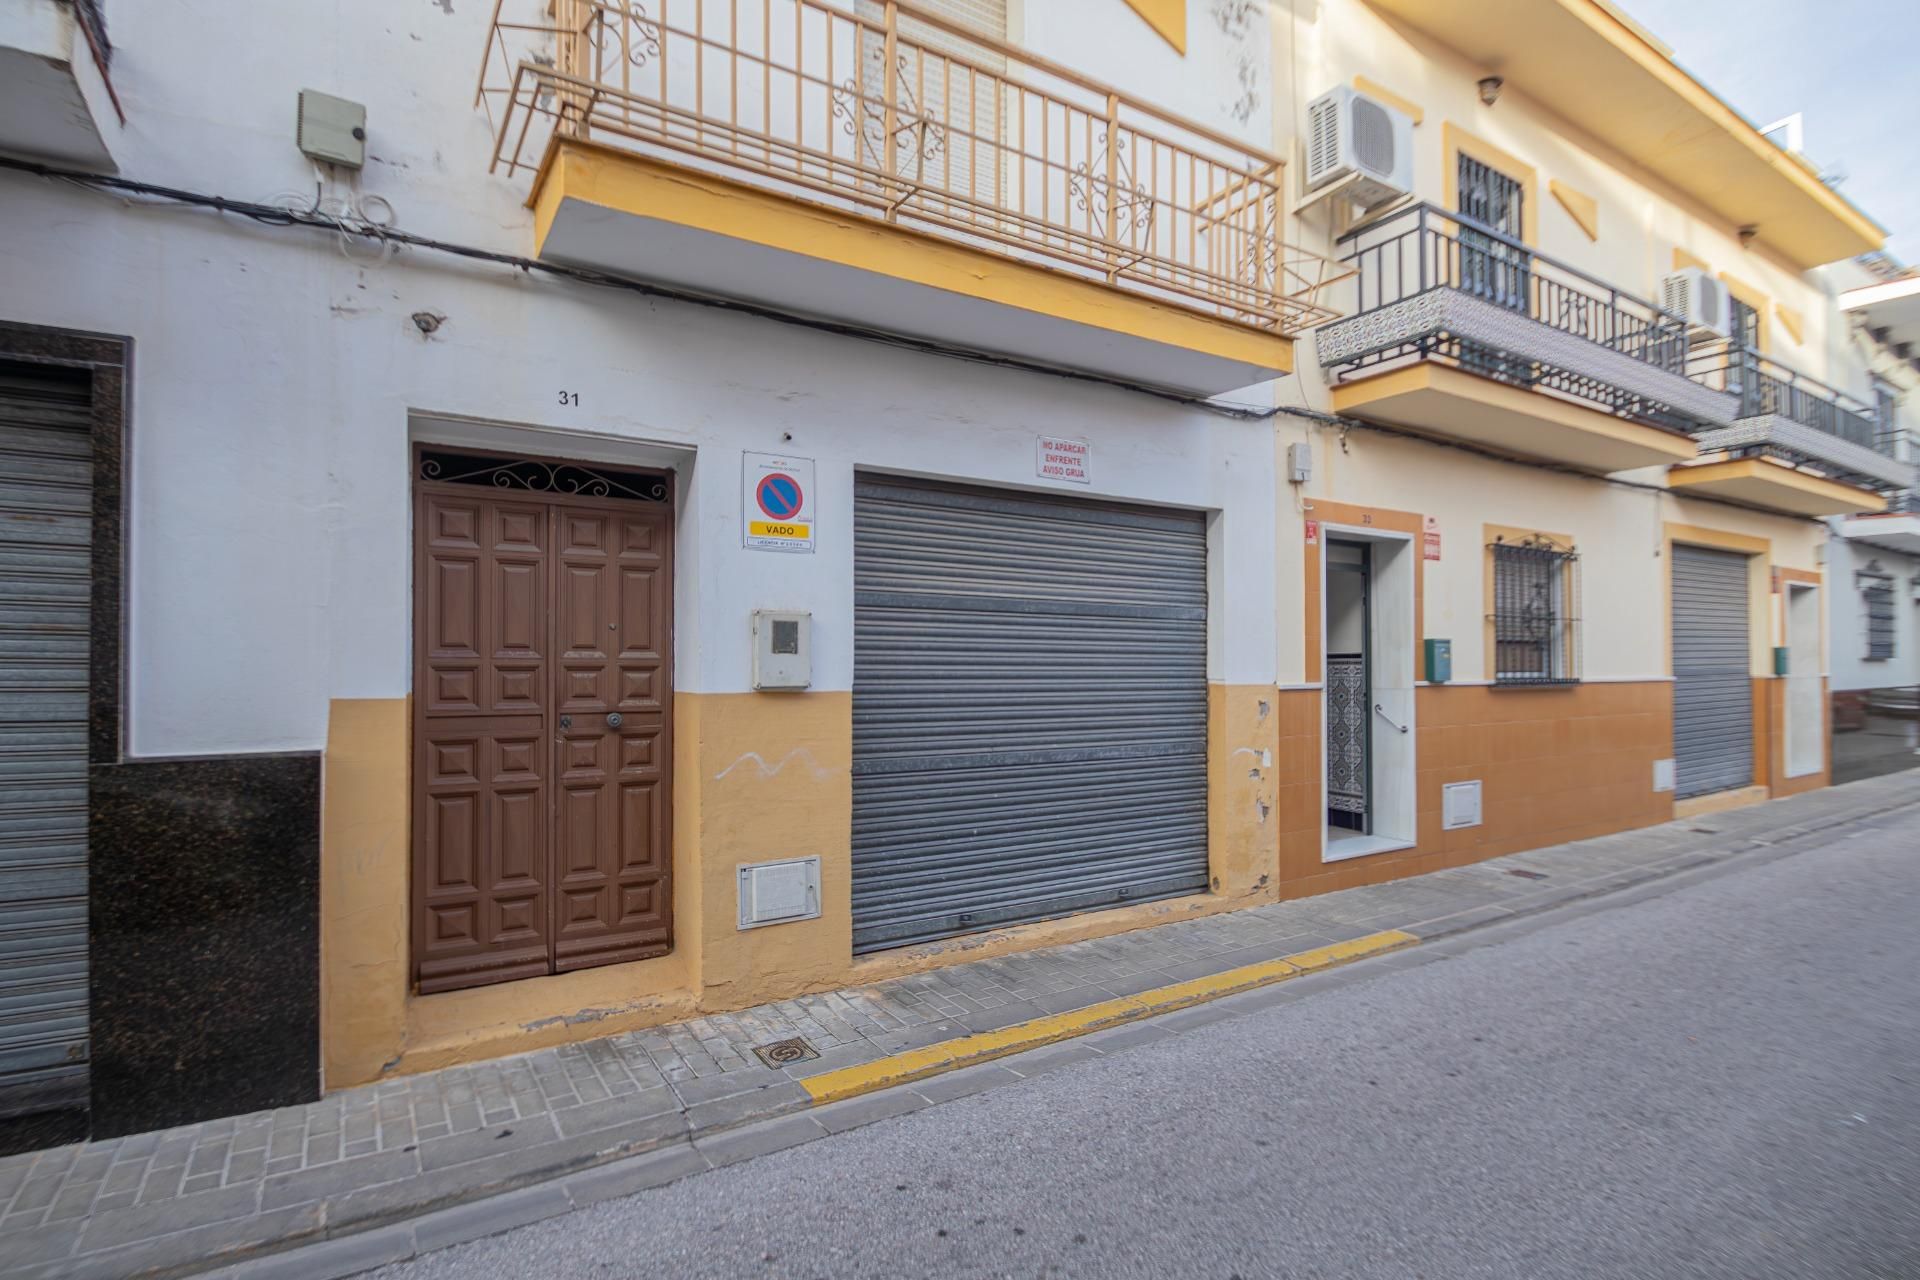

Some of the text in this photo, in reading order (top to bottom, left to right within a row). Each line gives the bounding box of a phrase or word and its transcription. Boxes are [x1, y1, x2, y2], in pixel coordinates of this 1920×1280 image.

[558, 390, 579, 407] 31
[1042, 440, 1086, 454] NO APARCAR
[1045, 453, 1081, 466] ENFRENTE
[1042, 465, 1085, 477] AVISO GRUA
[766, 525, 795, 536] VADO
